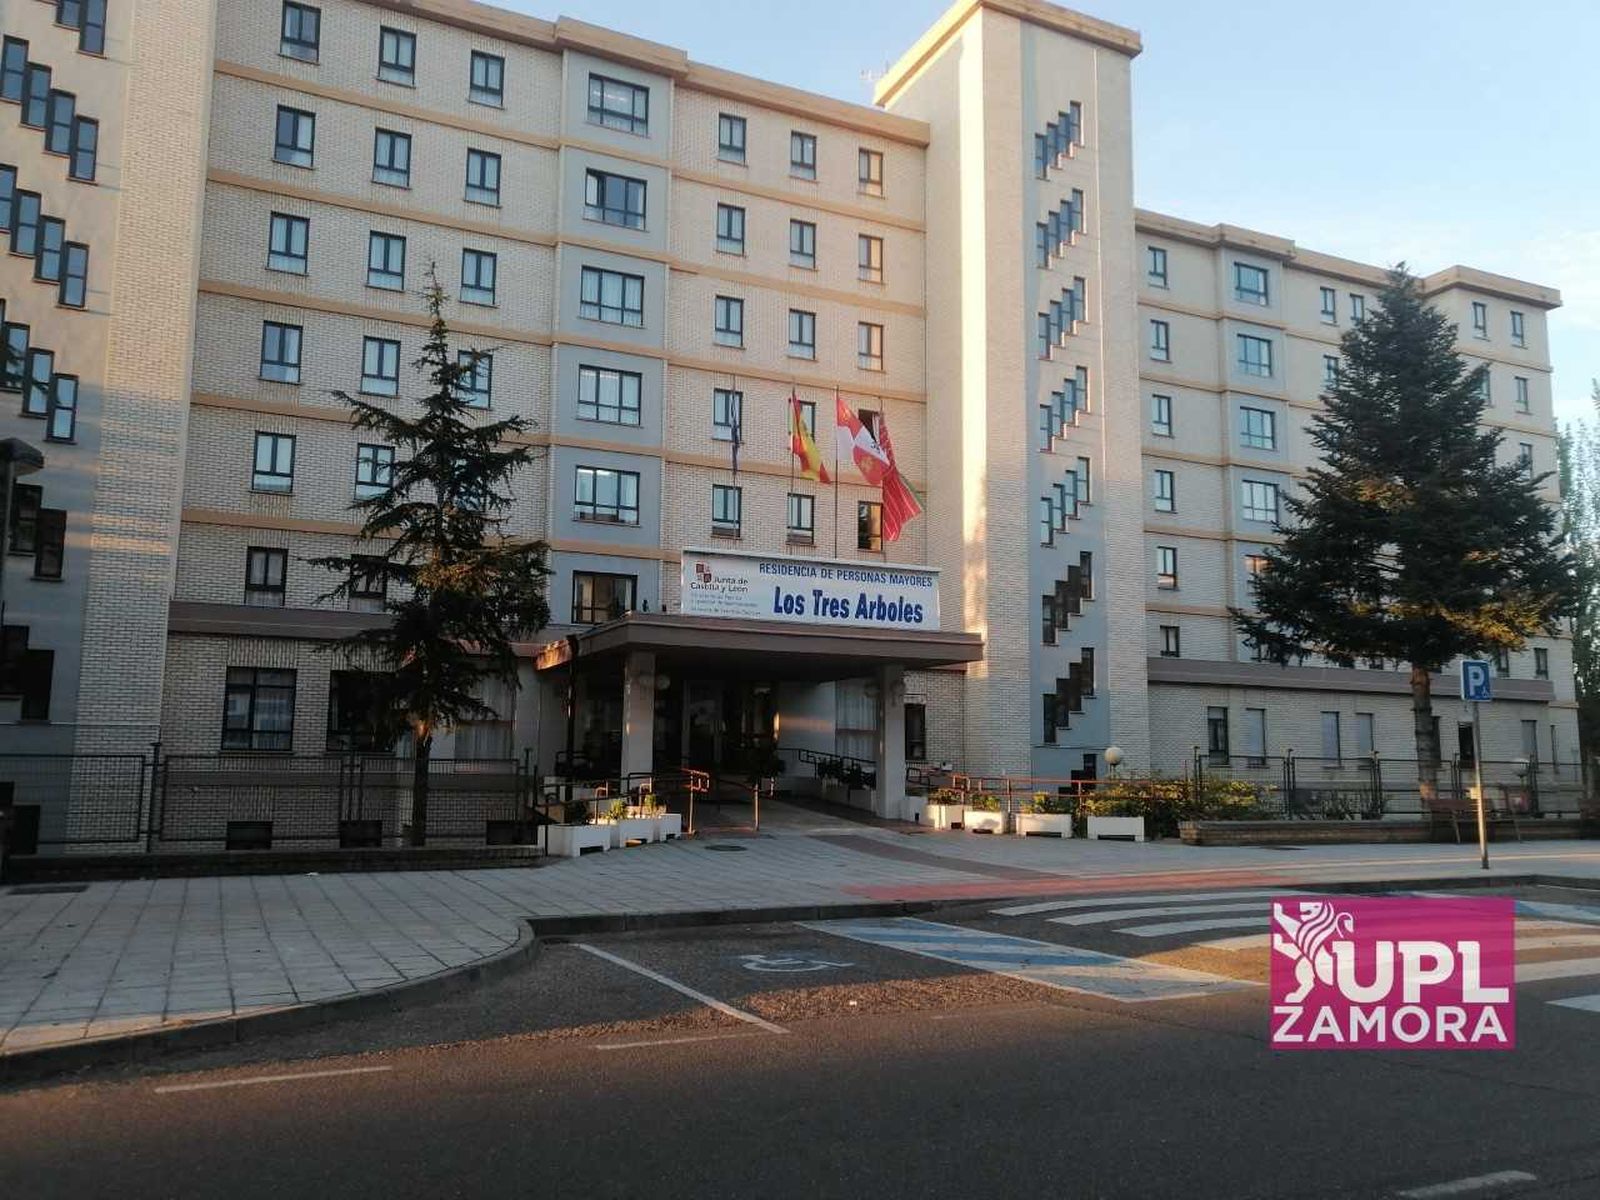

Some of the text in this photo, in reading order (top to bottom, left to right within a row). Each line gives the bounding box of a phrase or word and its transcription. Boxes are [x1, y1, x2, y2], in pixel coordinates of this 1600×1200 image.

[759, 562, 933, 588] RESIDENCIA DE PERSONAS MAYORES
[773, 586, 923, 624] Los Tres Arboles
[1468, 666, 1485, 696] P
